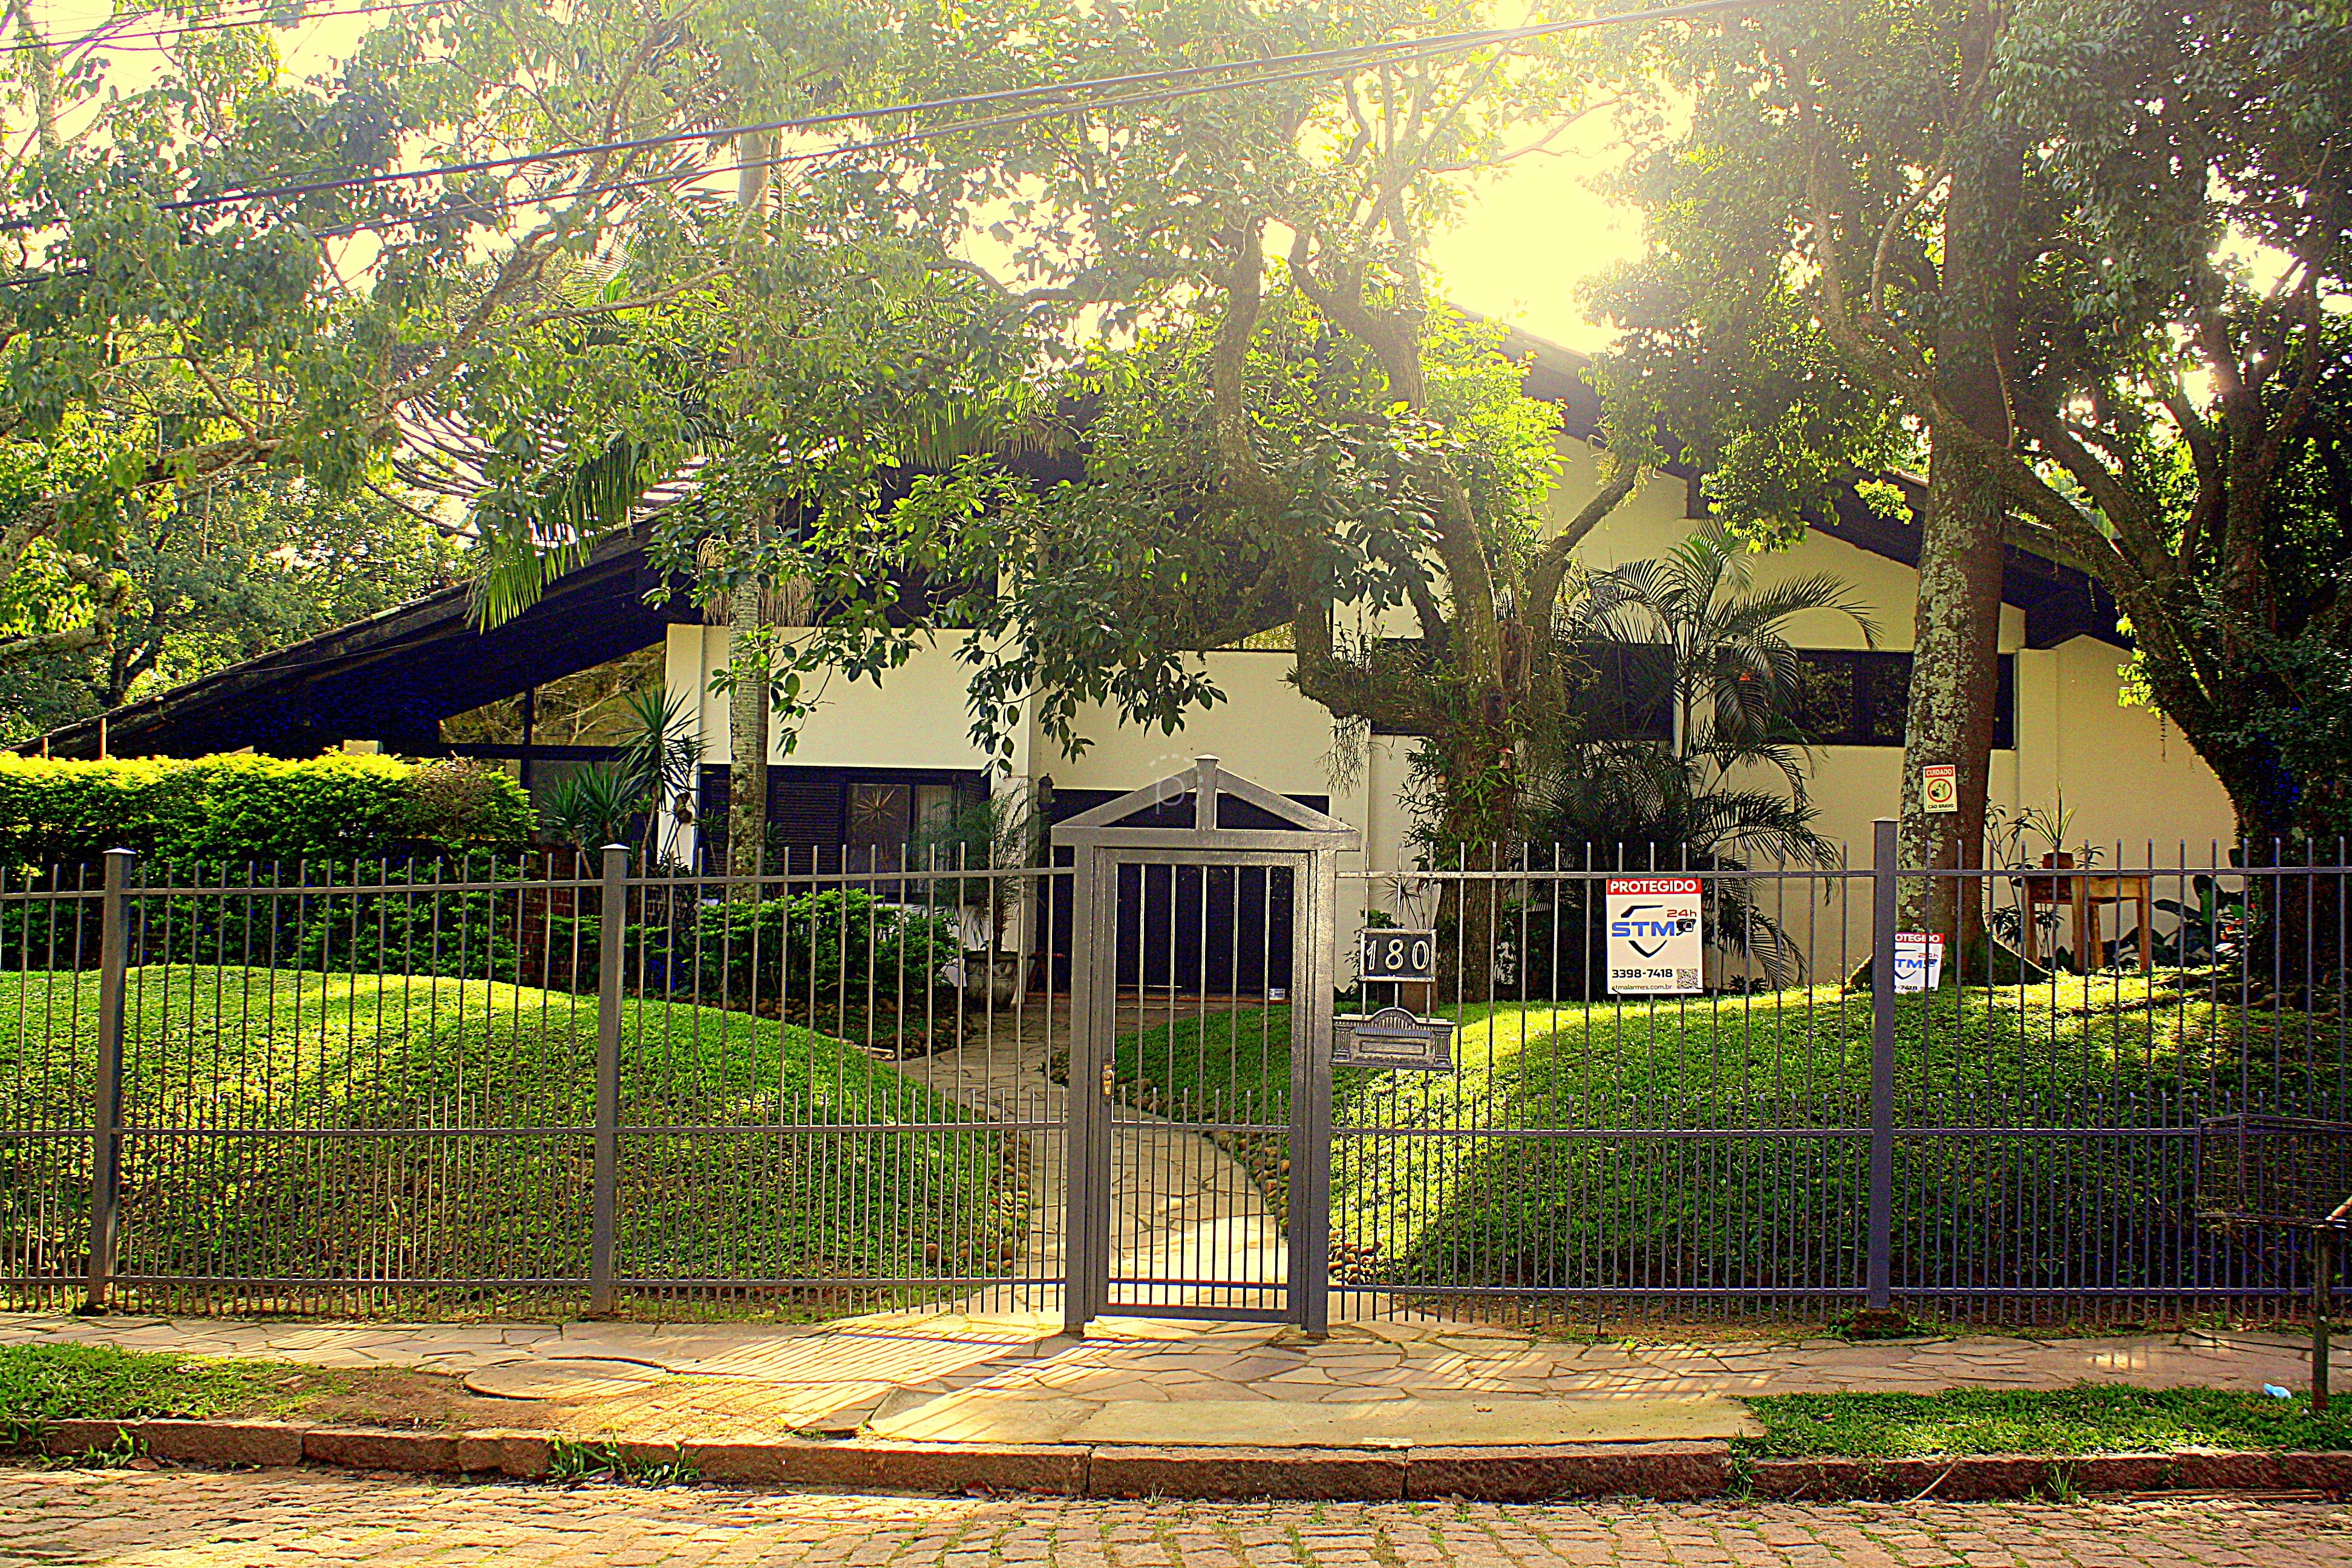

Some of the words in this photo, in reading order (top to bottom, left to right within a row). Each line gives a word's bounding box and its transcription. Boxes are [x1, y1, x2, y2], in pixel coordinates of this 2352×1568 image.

[1610, 880, 1697, 893] PROTEGIDO
[1612, 921, 1675, 936] STM
[1367, 939, 1429, 970] 180
[1612, 969, 1673, 978] 3398-7418
